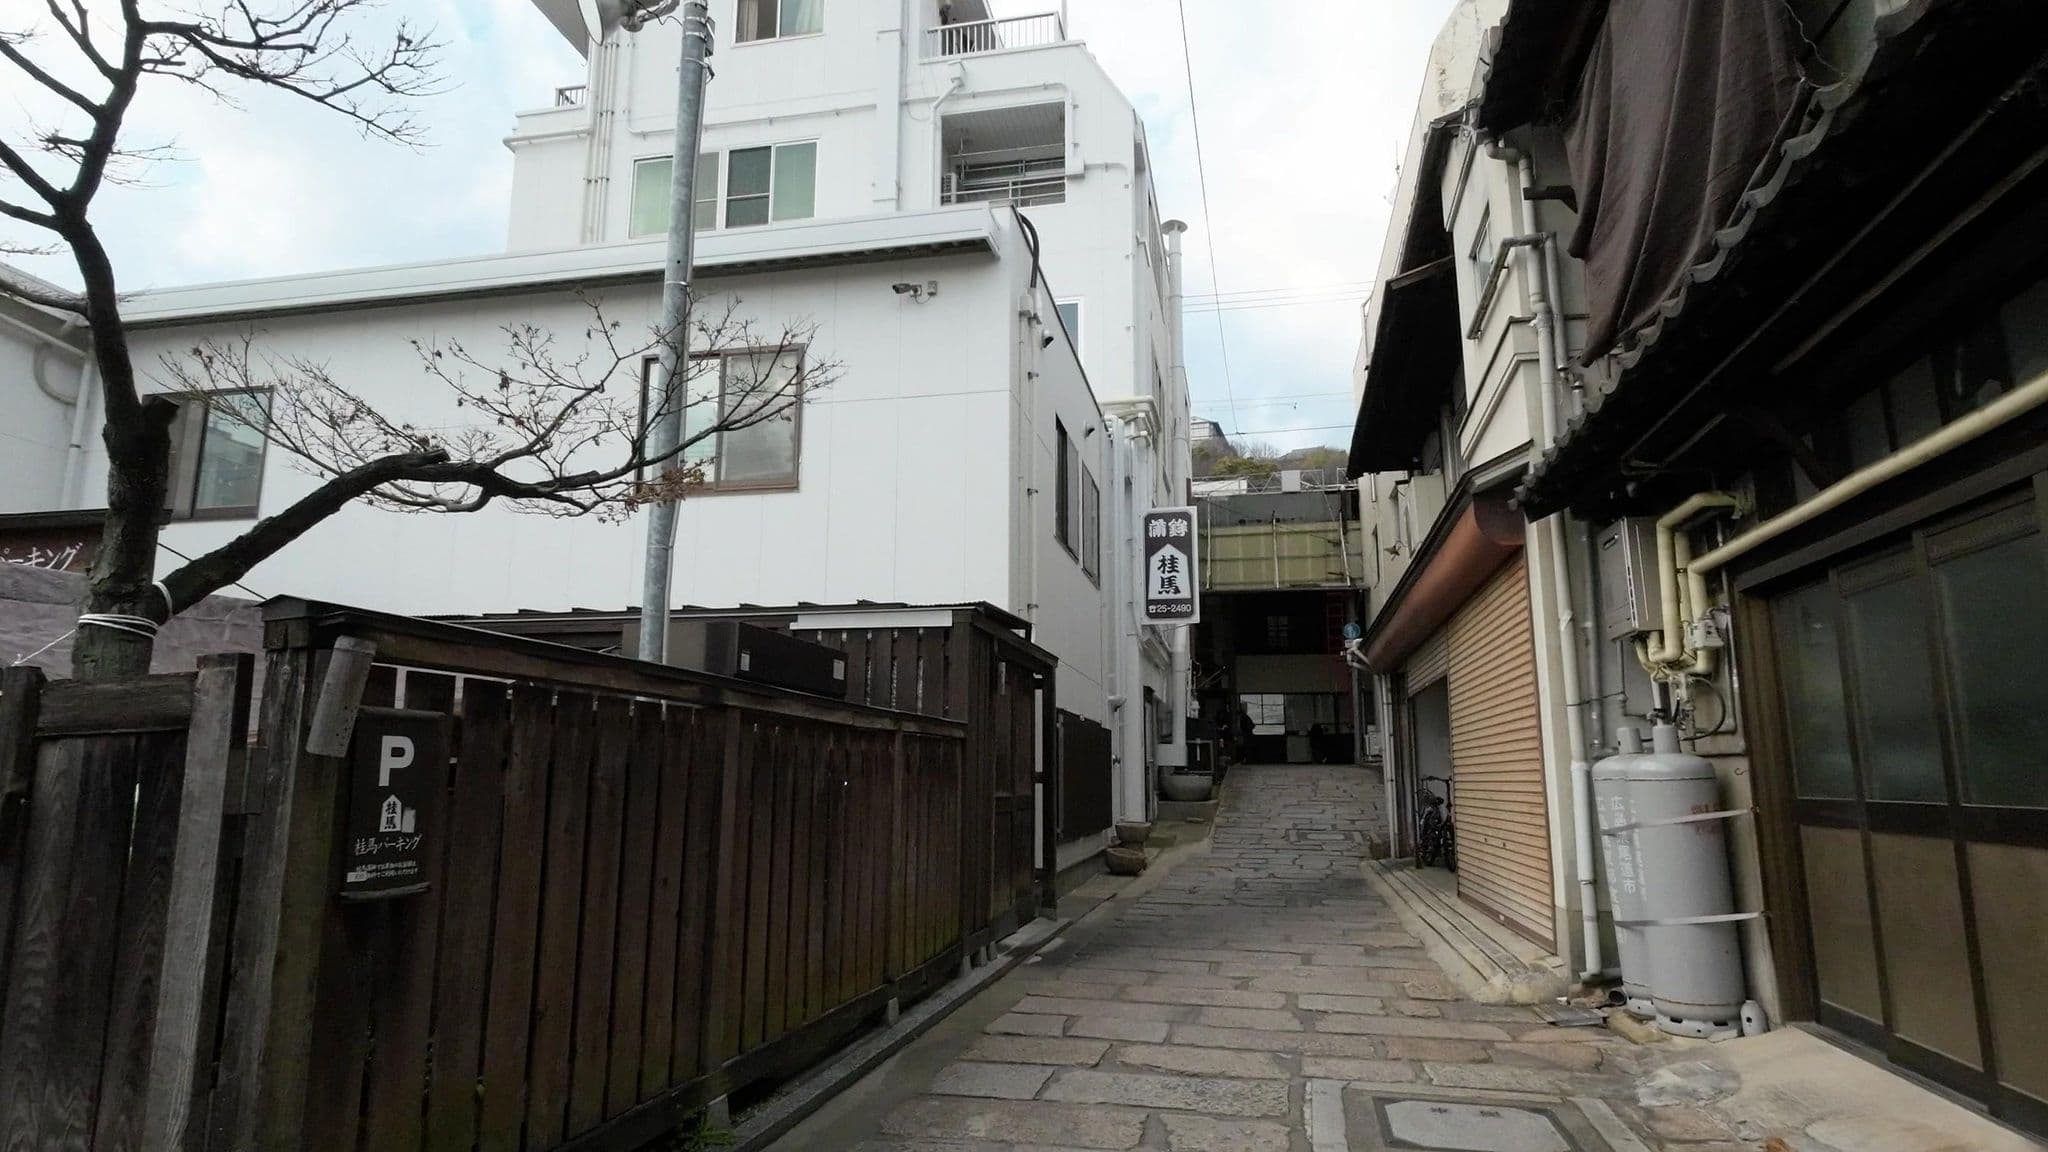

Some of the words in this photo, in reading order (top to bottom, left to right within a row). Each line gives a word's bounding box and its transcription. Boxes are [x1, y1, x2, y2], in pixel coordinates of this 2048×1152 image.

[1148, 518, 1188, 538] 蒲鉾
[1157, 554, 1181, 595] 桂馬
[378, 735, 415, 786] P
[384, 801, 397, 829] 桂馬
[355, 833, 423, 855] 桂馬パーキング
